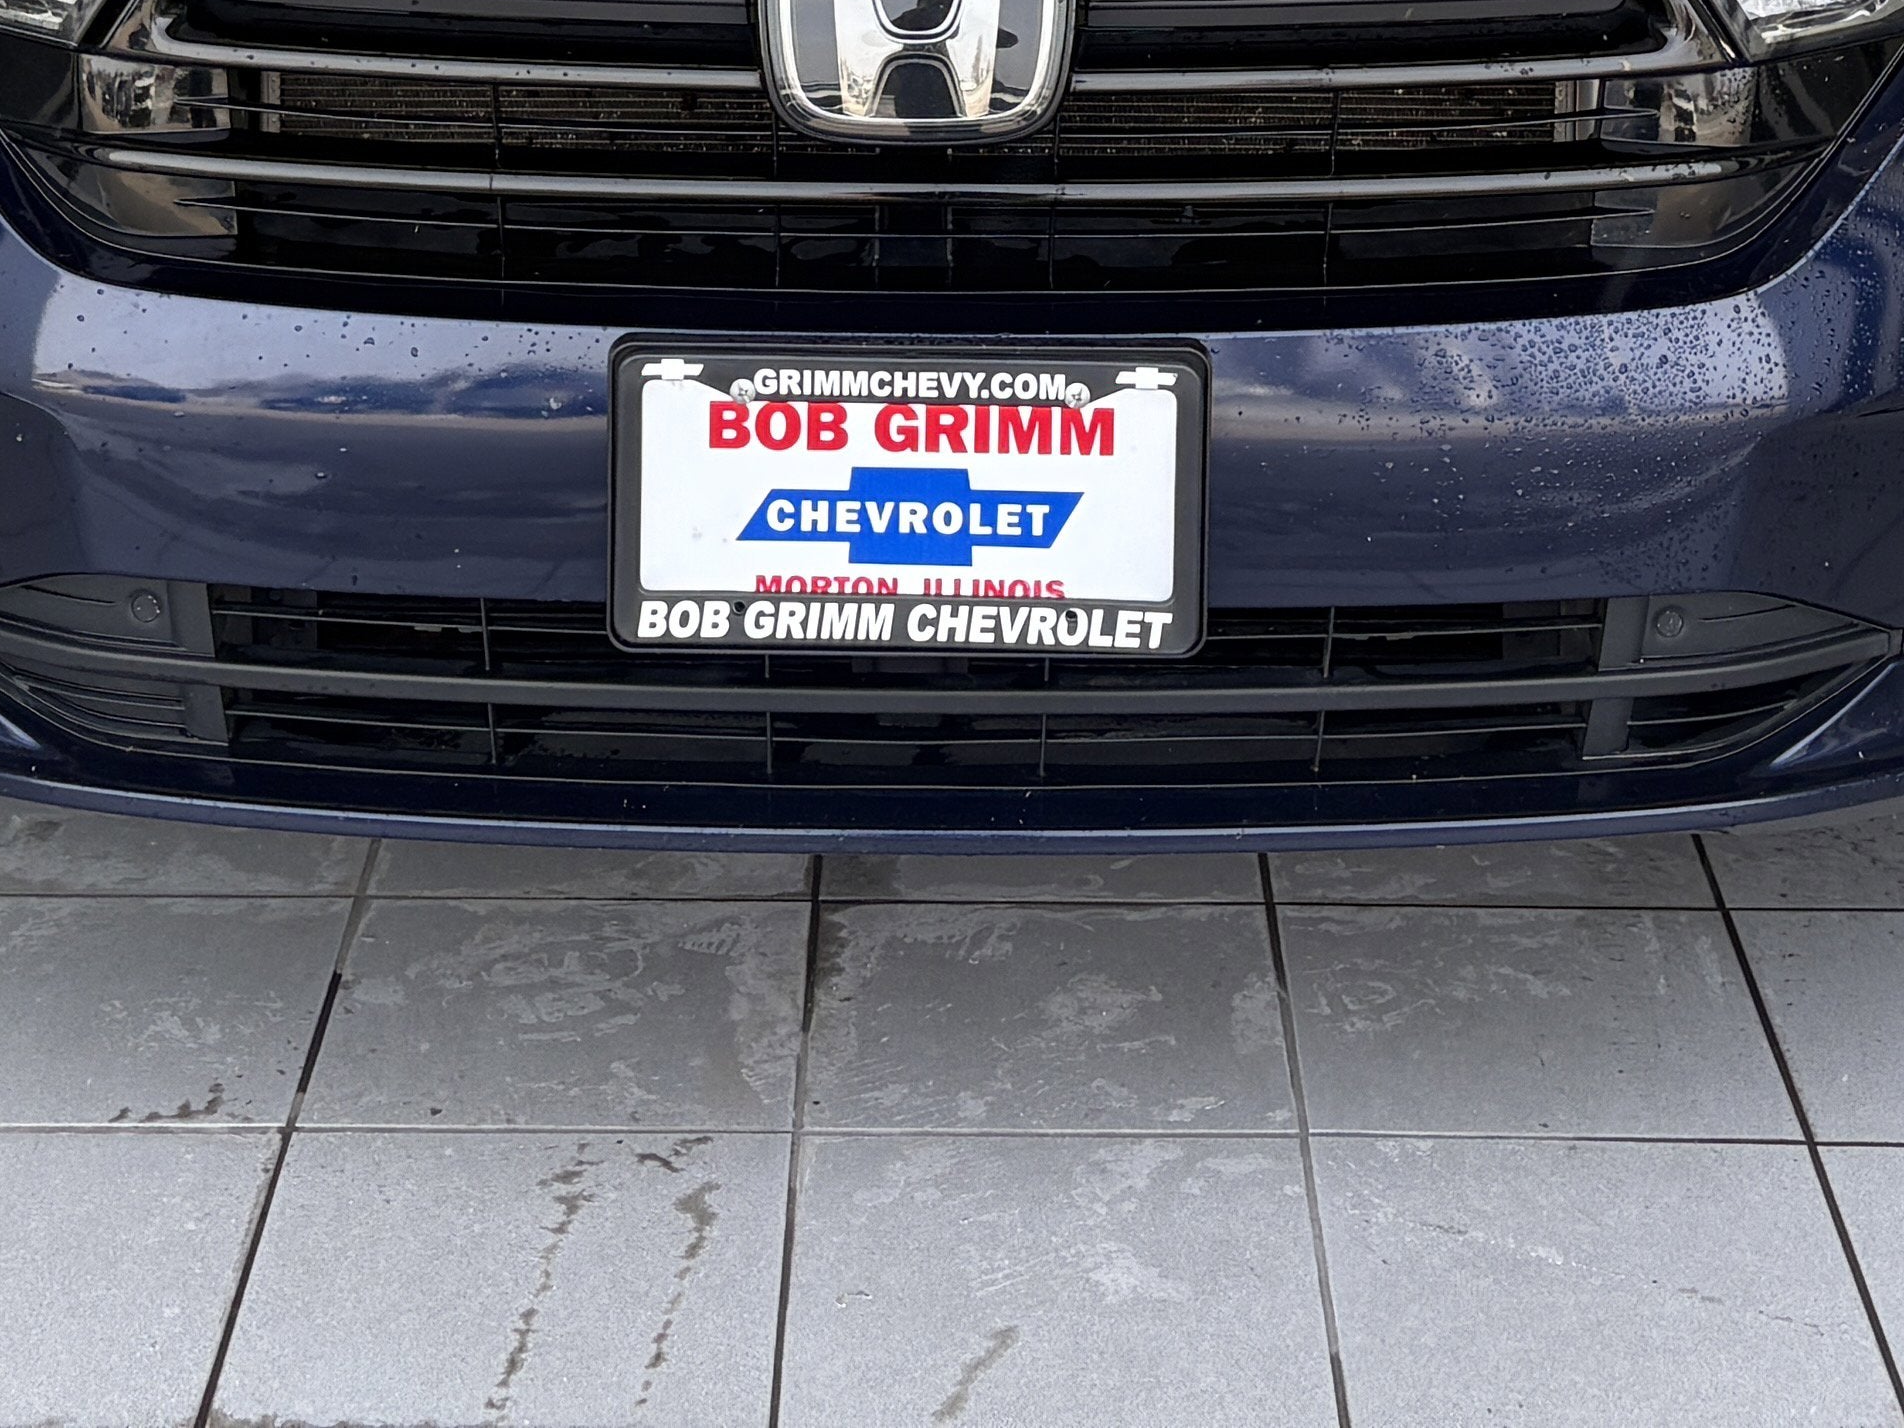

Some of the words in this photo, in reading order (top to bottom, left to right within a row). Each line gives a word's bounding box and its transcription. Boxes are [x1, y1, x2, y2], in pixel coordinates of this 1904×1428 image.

[752, 367, 1067, 401] GRIMMCHEVY.COM
[708, 401, 849, 449] BOB
[874, 403, 1114, 457] GRIMM
[766, 499, 1051, 538] CHEVROLET
[755, 574, 899, 594] MORTON
[637, 600, 731, 639] BOB
[743, 602, 895, 642] GRIMM
[906, 604, 1173, 649] CHEVROLET
